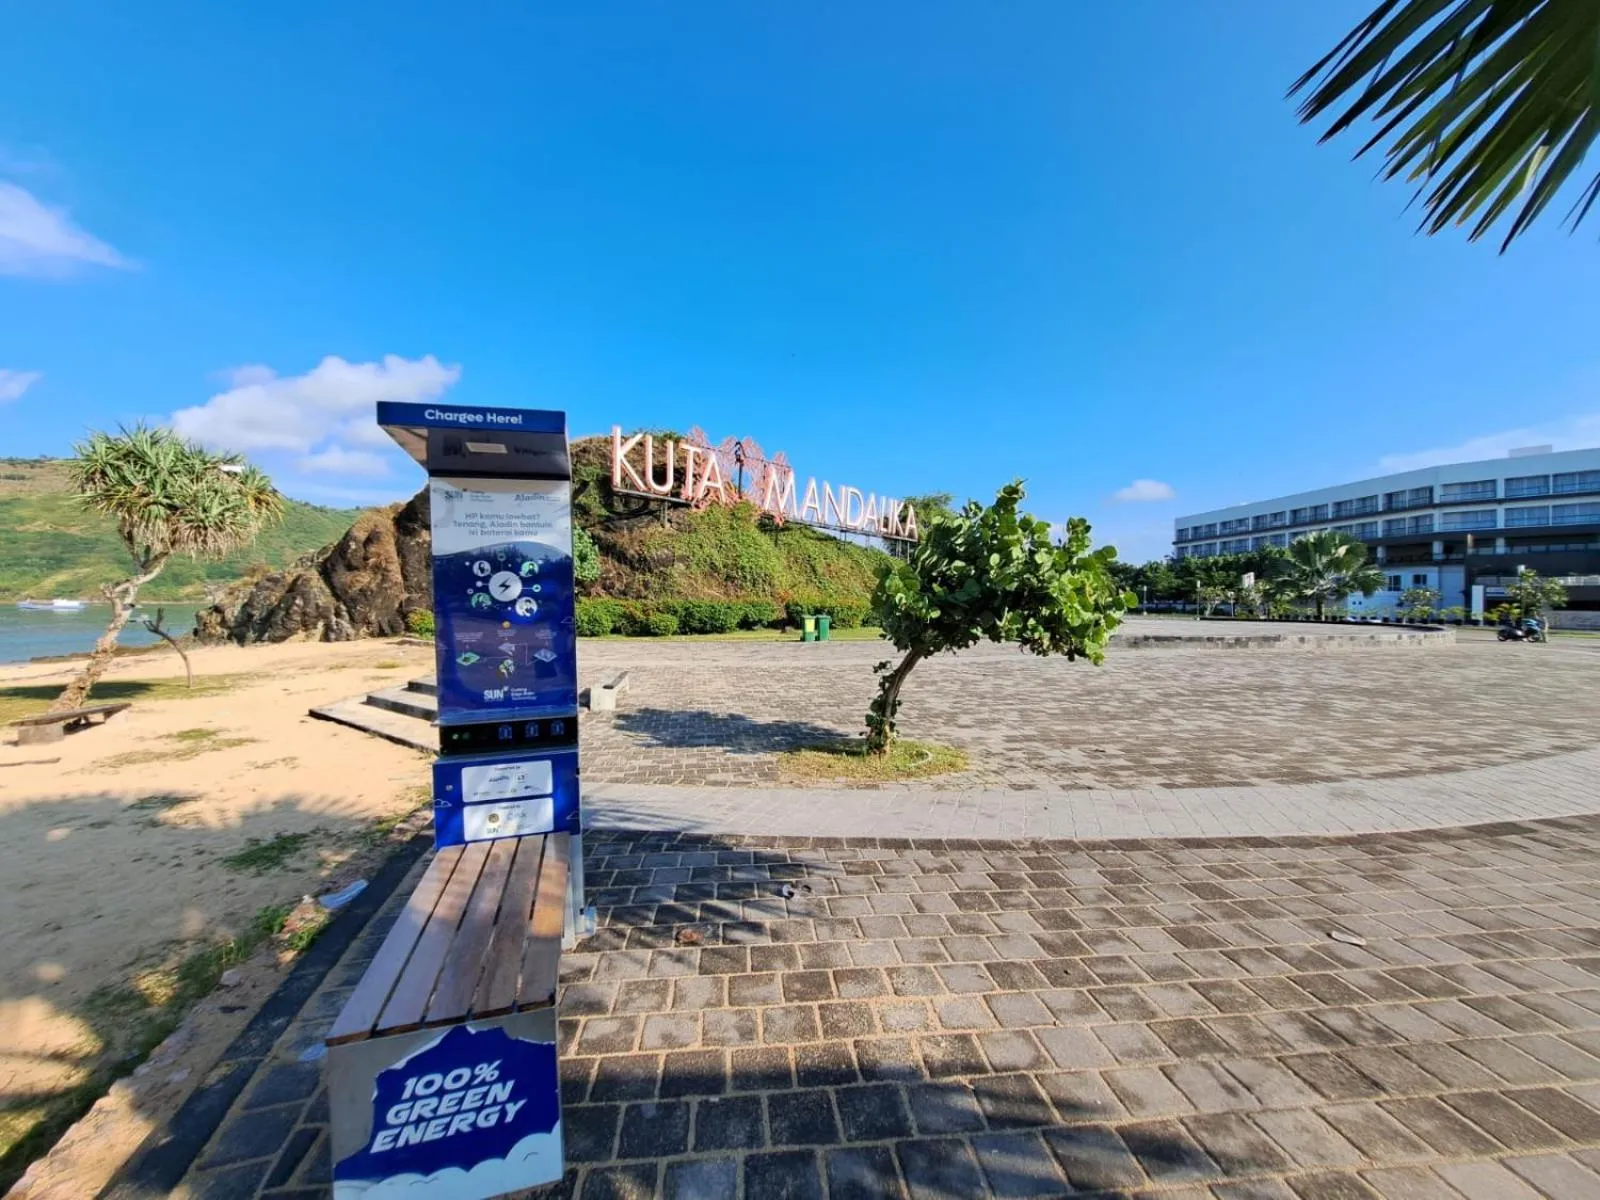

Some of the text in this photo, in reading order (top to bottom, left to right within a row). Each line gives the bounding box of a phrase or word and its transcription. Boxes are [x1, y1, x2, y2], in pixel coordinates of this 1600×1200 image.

[424, 409, 523, 425] Chargee Here!
[612, 426, 919, 540] KUTA MANDALIKA
[483, 689, 504, 701] SUN
[401, 1059, 503, 1100] 100%
[386, 1079, 516, 1126] GREEN
[369, 1098, 528, 1154] ENERGY
